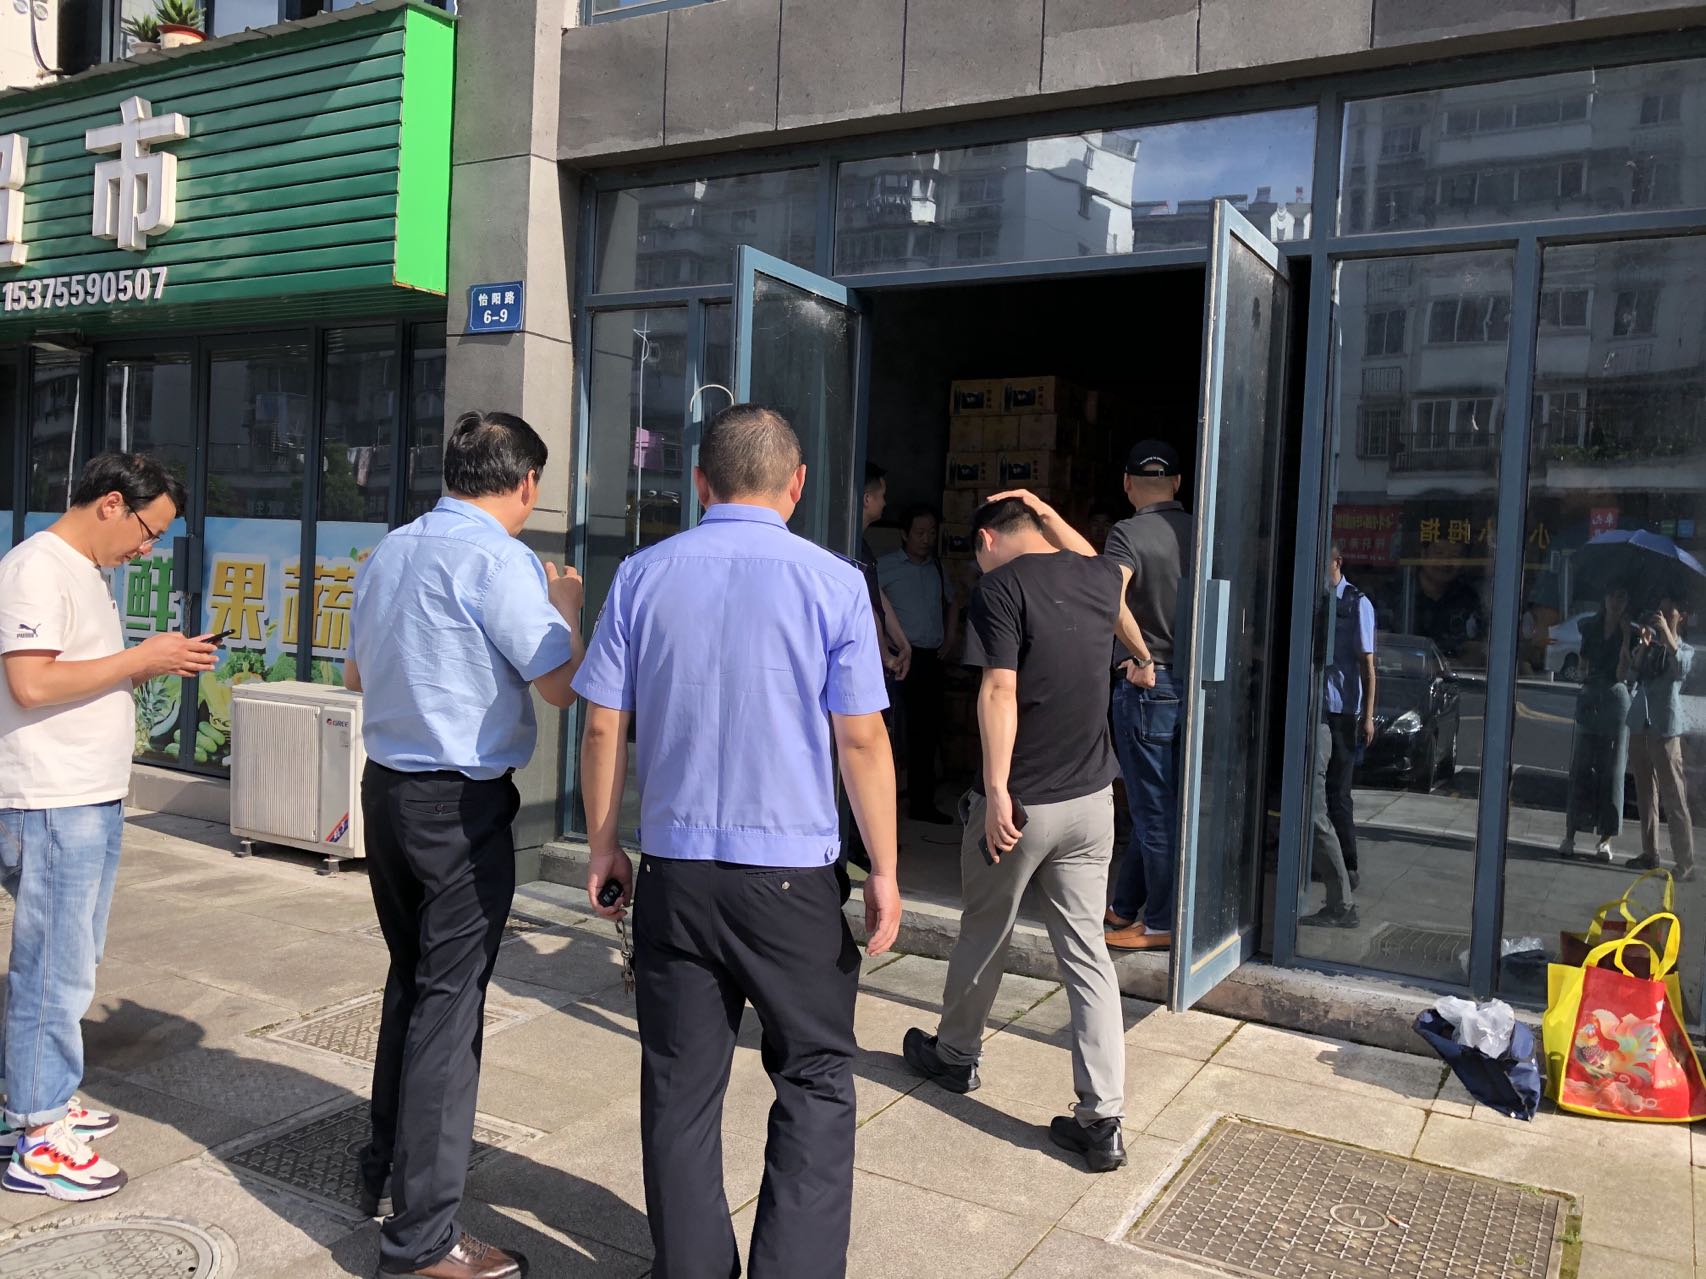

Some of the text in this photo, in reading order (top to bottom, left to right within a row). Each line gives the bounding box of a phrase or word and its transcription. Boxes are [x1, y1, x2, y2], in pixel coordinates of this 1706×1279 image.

[3, 267, 167, 311] 15375590507
[478, 290, 515, 307] 怡阳路
[484, 308, 508, 324] 6-9
[126, 554, 356, 650] 鲜果蔬
